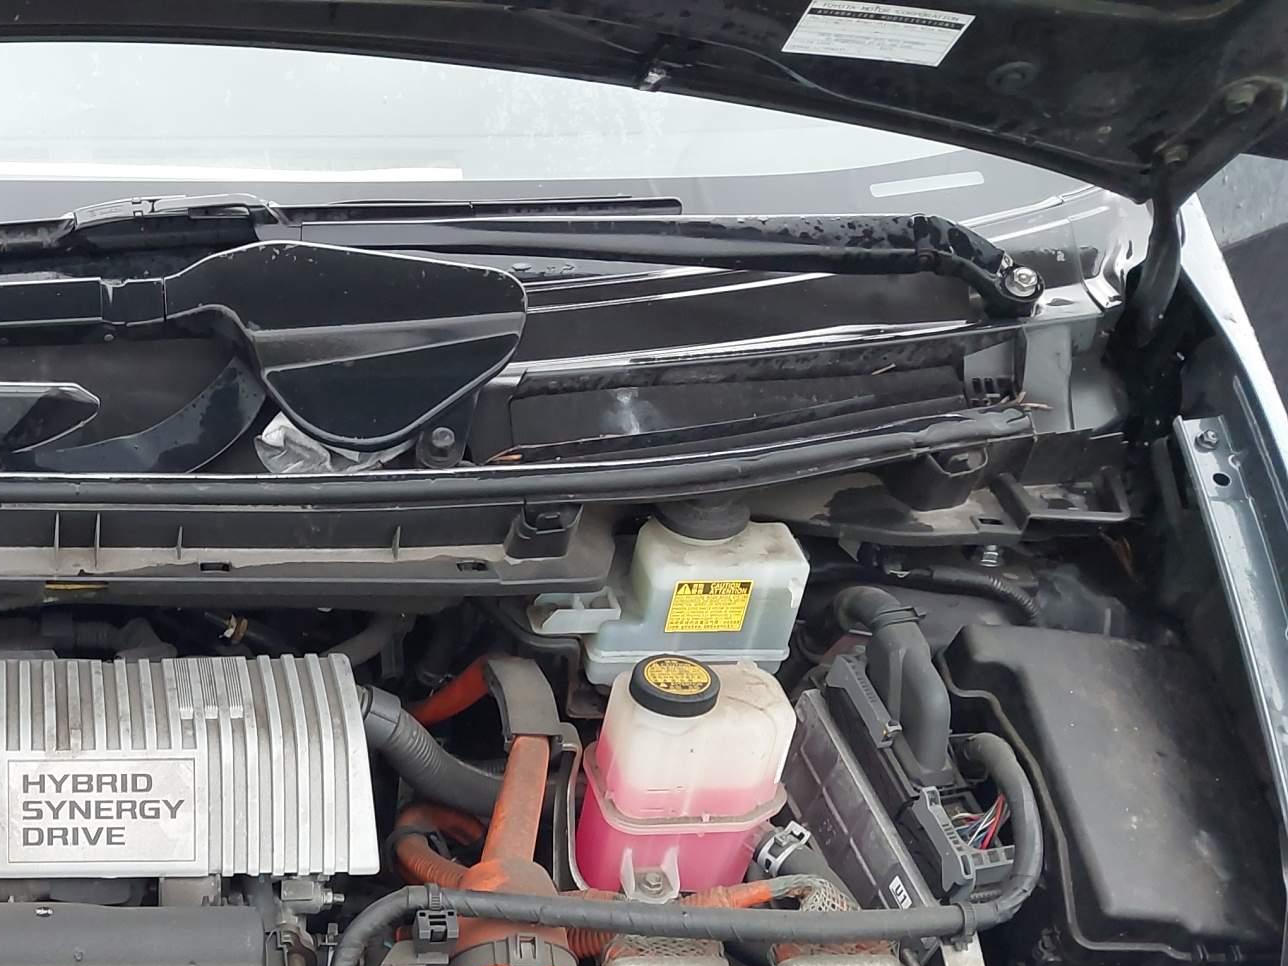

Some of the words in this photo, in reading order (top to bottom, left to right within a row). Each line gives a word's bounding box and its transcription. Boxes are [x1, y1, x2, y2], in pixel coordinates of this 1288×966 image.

[22, 773, 153, 794] HYBRID
[22, 799, 185, 821] SYNERGY
[22, 826, 126, 847] DRIVE
